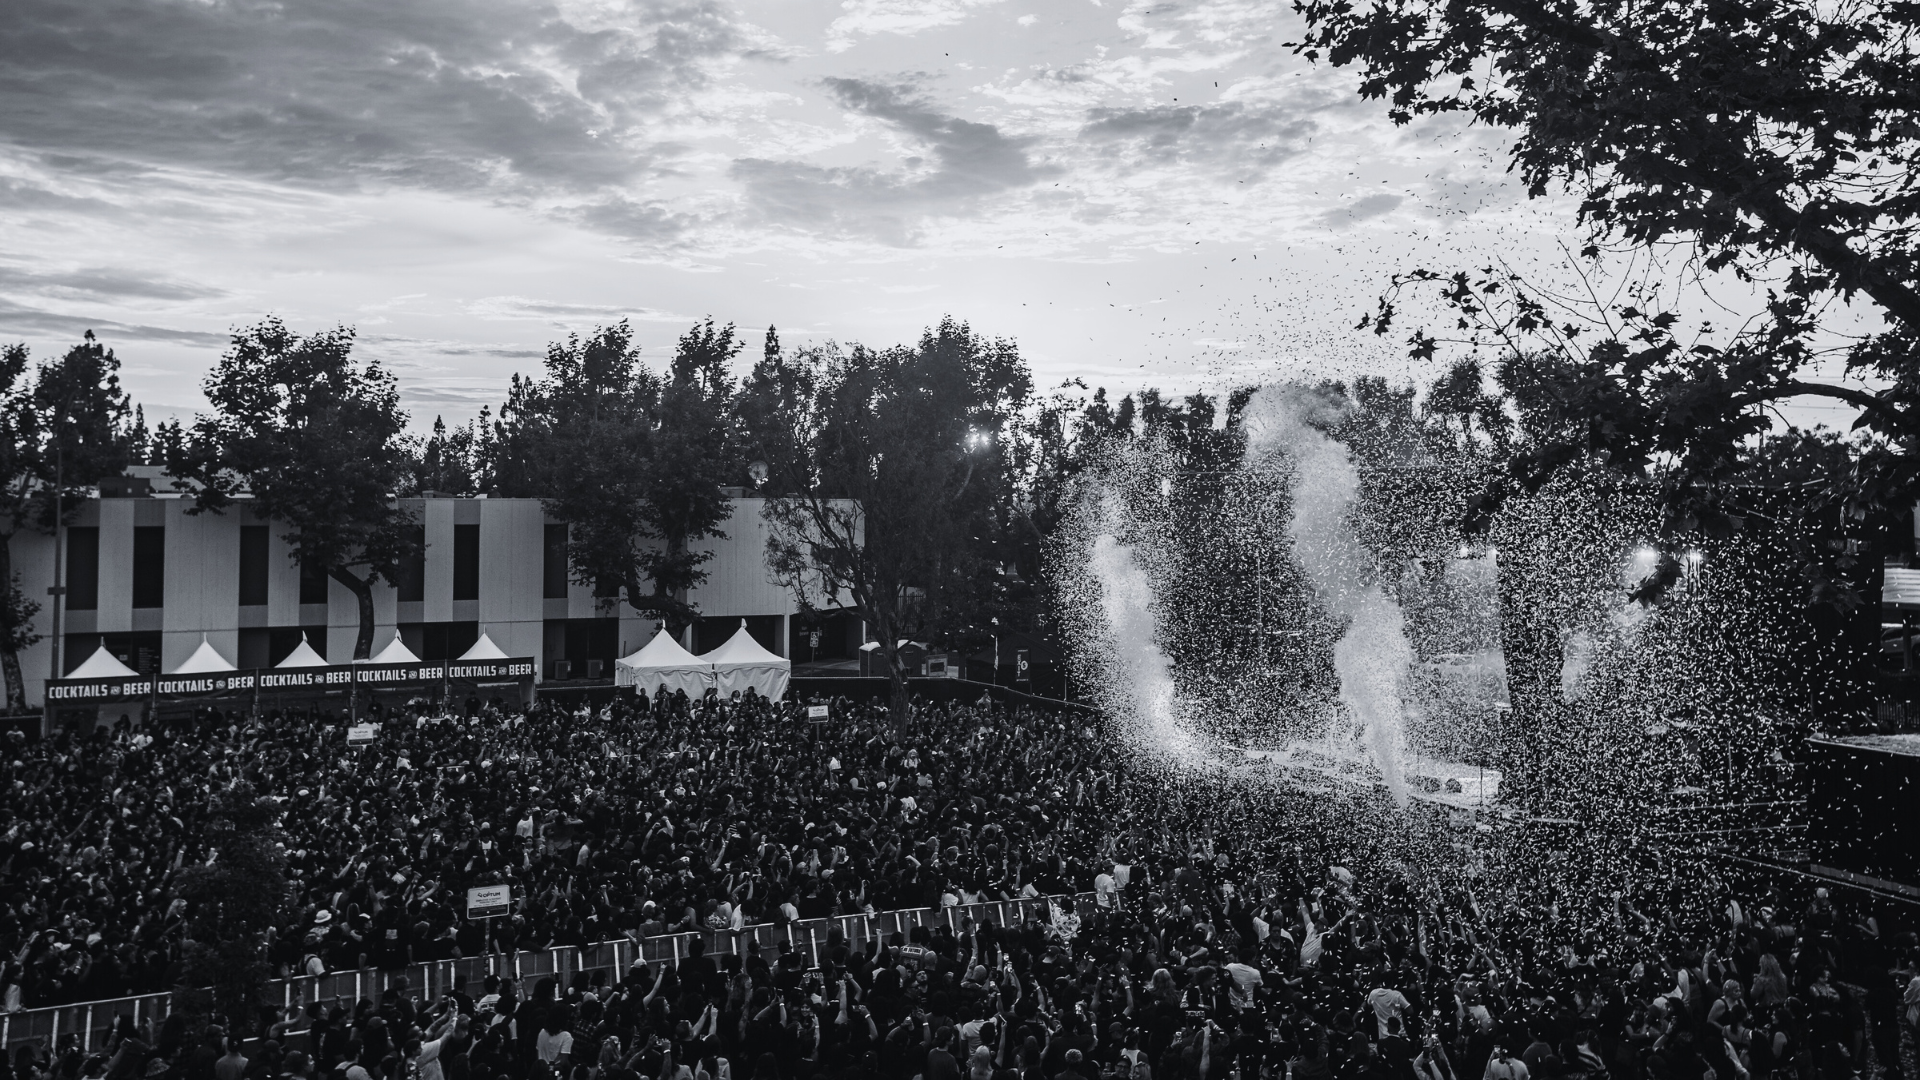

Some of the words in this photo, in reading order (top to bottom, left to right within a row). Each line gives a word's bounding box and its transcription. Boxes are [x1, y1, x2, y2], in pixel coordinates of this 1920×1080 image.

[260, 673, 313, 687] COCKTAILS
[326, 671, 351, 684] BEER
[357, 669, 406, 682] COCKTAILS
[419, 667, 443, 680] BEER
[449, 665, 497, 678] COCKTAILS
[508, 664, 532, 676] BEER
[48, 684, 108, 699] COCKTAILS
[123, 682, 151, 695] BEER
[158, 679, 214, 693] COCKTAILS
[227, 676, 254, 689] BEER
